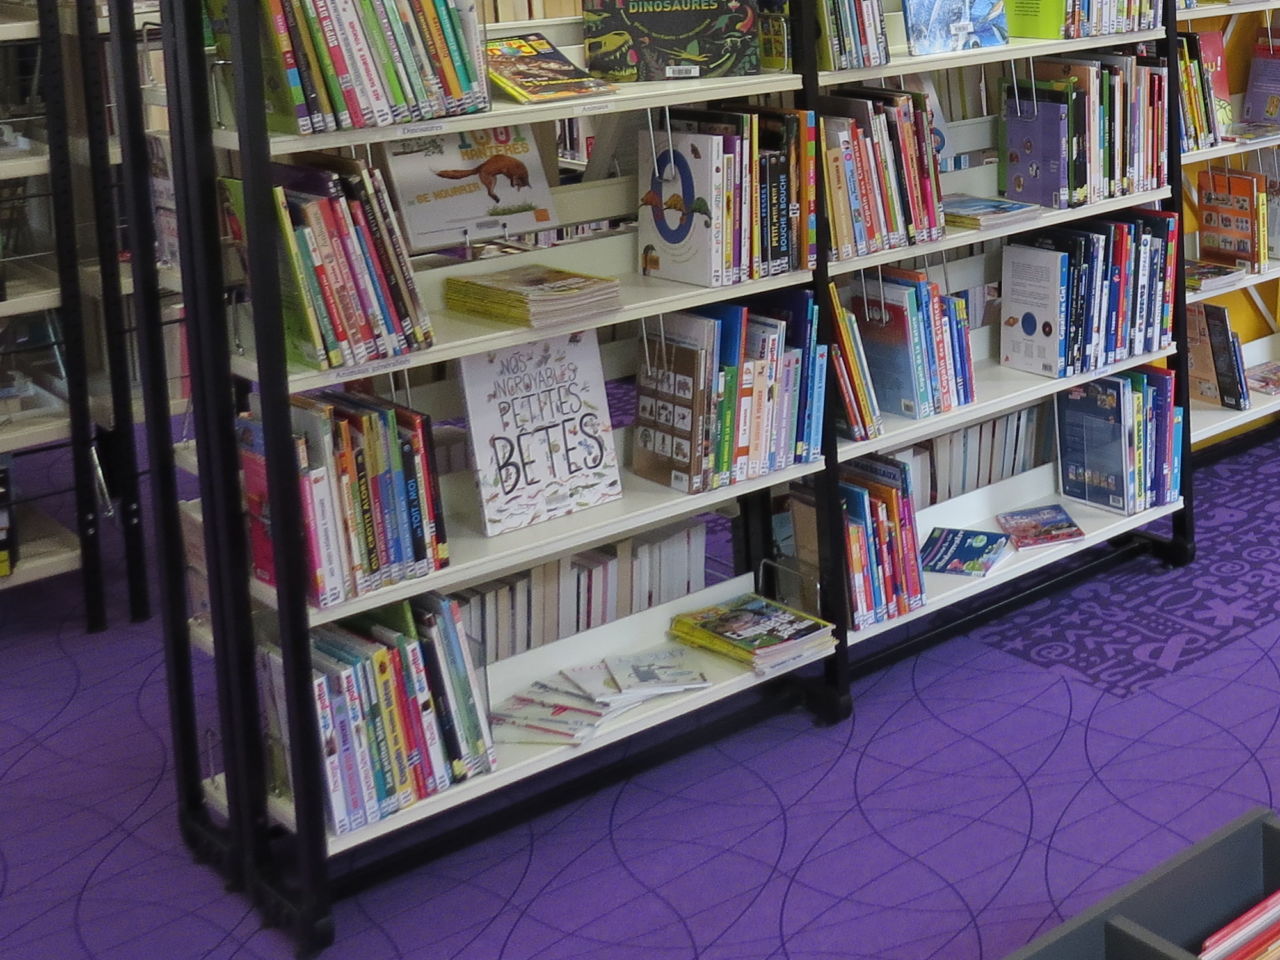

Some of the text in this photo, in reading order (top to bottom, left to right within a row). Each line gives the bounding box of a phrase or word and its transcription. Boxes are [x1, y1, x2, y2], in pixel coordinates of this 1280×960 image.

[321, 18, 338, 47] SUPER
[850, 138, 873, 227] Copain des Chevaux
[779, 216, 787, 251] BOUCHE
[910, 315, 920, 343] Nature
[1057, 285, 1066, 340] Copain du Ciel
[930, 295, 949, 393] Copain des Sciences
[493, 362, 579, 398] INCROYABLES
[916, 364, 926, 392] Copain
[499, 382, 583, 433] PETITES
[1135, 419, 1144, 451] Terre
[492, 412, 606, 496] BÊTES
[1135, 464, 1145, 498] Copain
